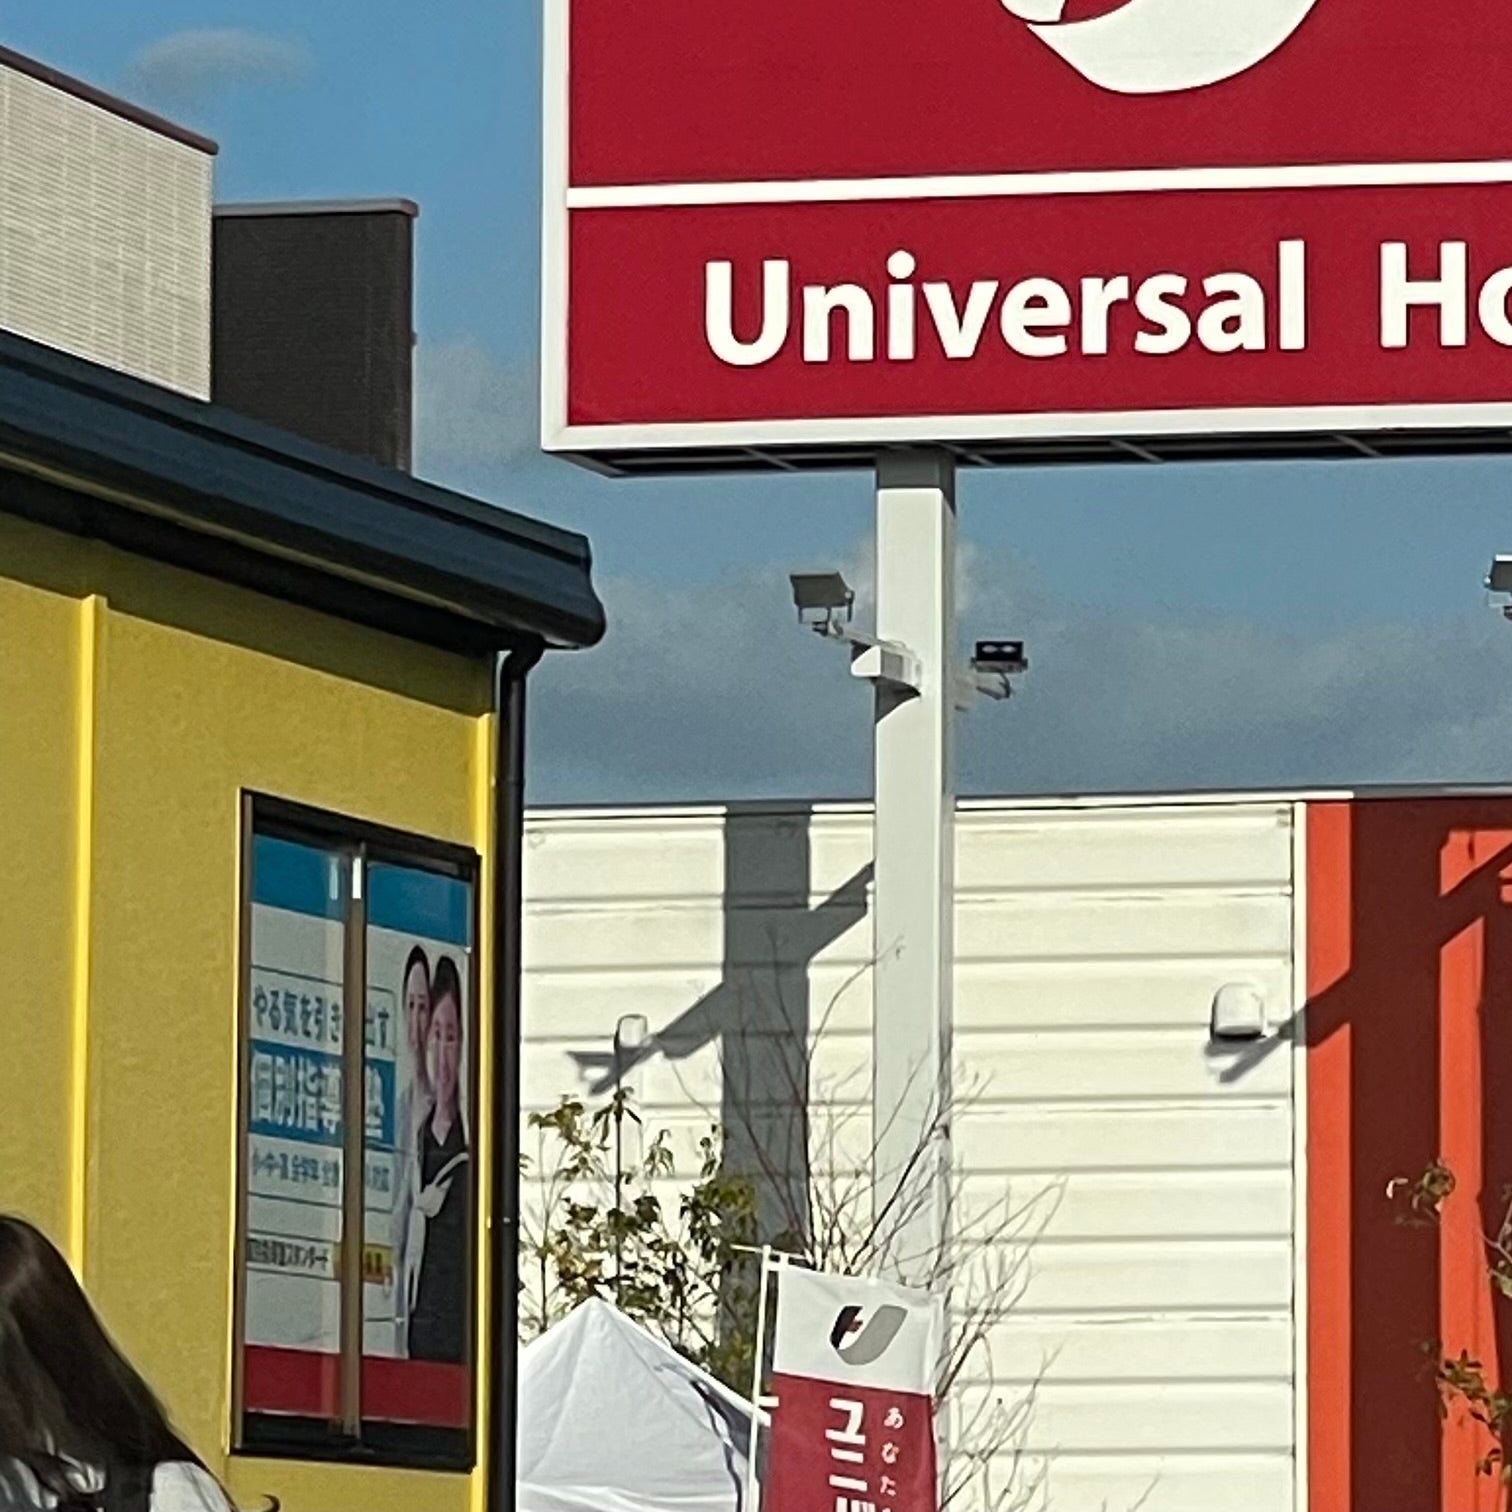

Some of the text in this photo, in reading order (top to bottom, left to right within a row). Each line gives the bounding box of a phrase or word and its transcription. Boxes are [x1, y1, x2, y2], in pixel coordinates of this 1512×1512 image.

[704, 239, 1305, 366] Universal
[880, 1407, 904, 1512] あなた
